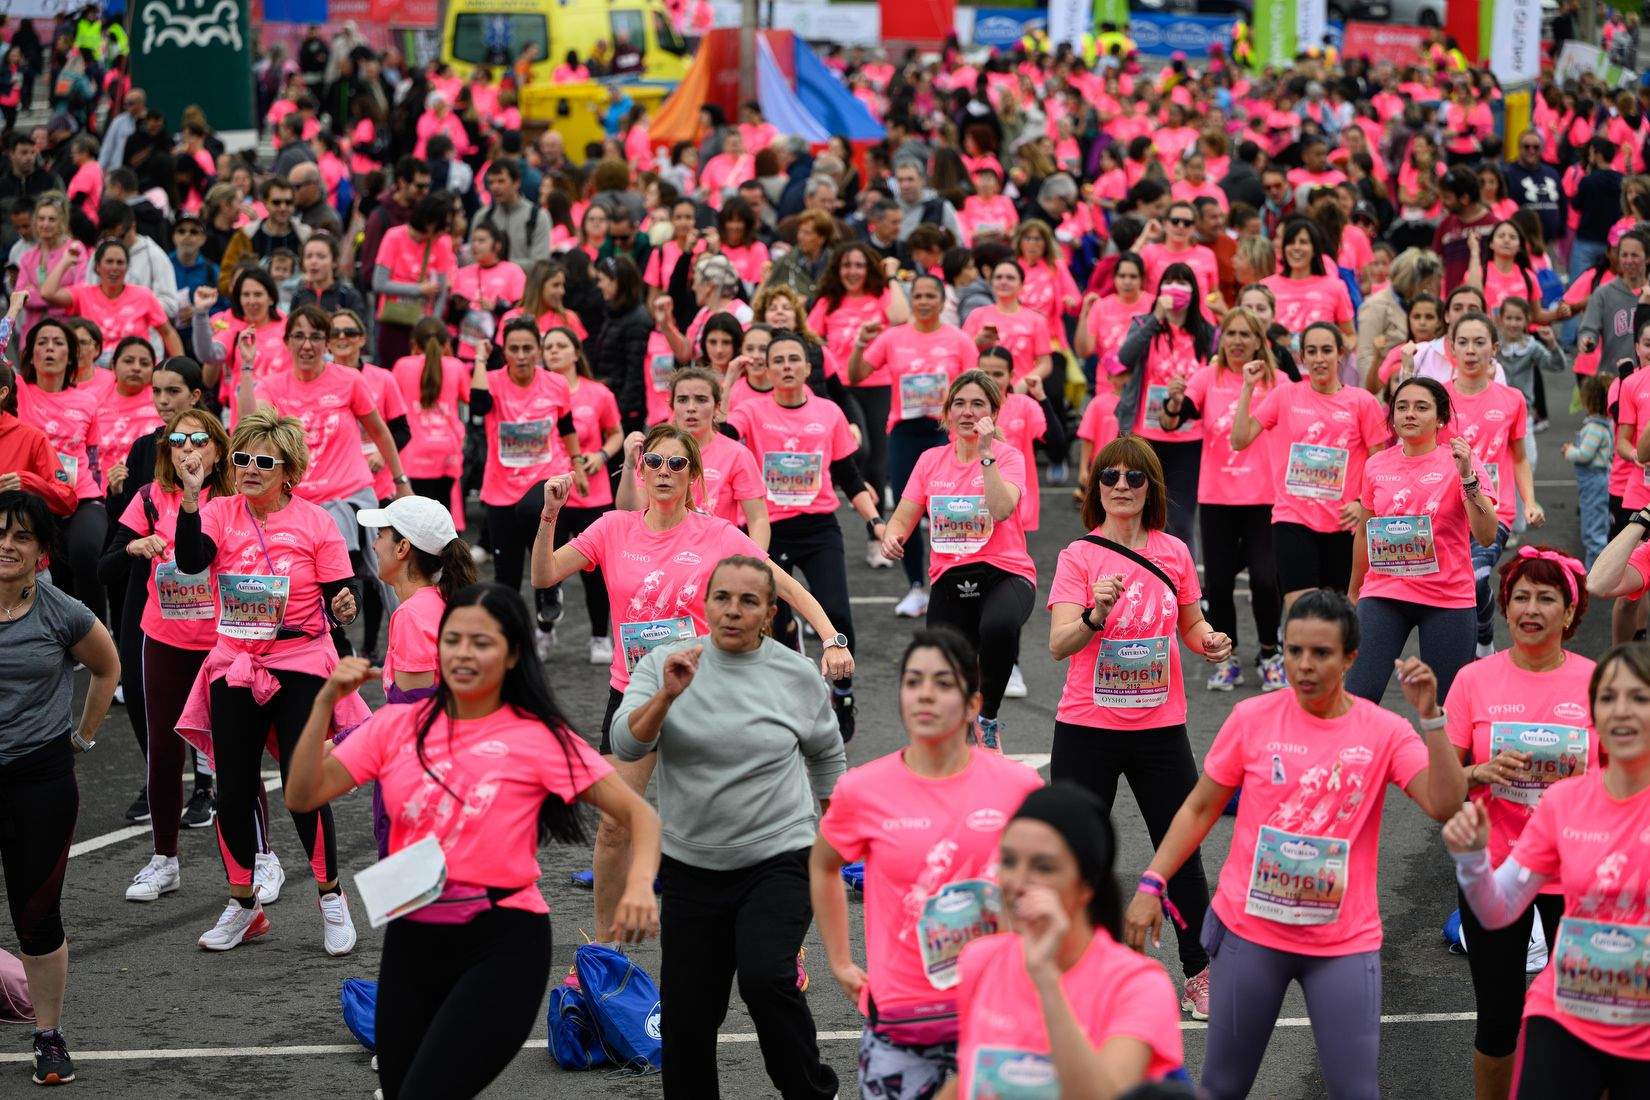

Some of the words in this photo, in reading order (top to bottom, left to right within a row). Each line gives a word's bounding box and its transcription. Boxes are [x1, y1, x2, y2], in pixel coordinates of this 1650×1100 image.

[950, 521, 973, 531] 016
[1389, 543, 1414, 554] 016
[179, 584, 206, 596] 016
[238, 583, 265, 591] ASTURIANA
[240, 602, 267, 614] 016
[641, 630, 670, 639] ASTURIANA
[1119, 649, 1148, 657] ASTURIANA
[1120, 669, 1150, 681] 016
[1101, 696, 1127, 704] OYSHO
[1488, 703, 1526, 714] OYSHO
[1522, 733, 1558, 743] ASTURIANA
[1523, 760, 1556, 773] 016
[1279, 871, 1314, 890] 016
[1590, 967, 1631, 985] 016
